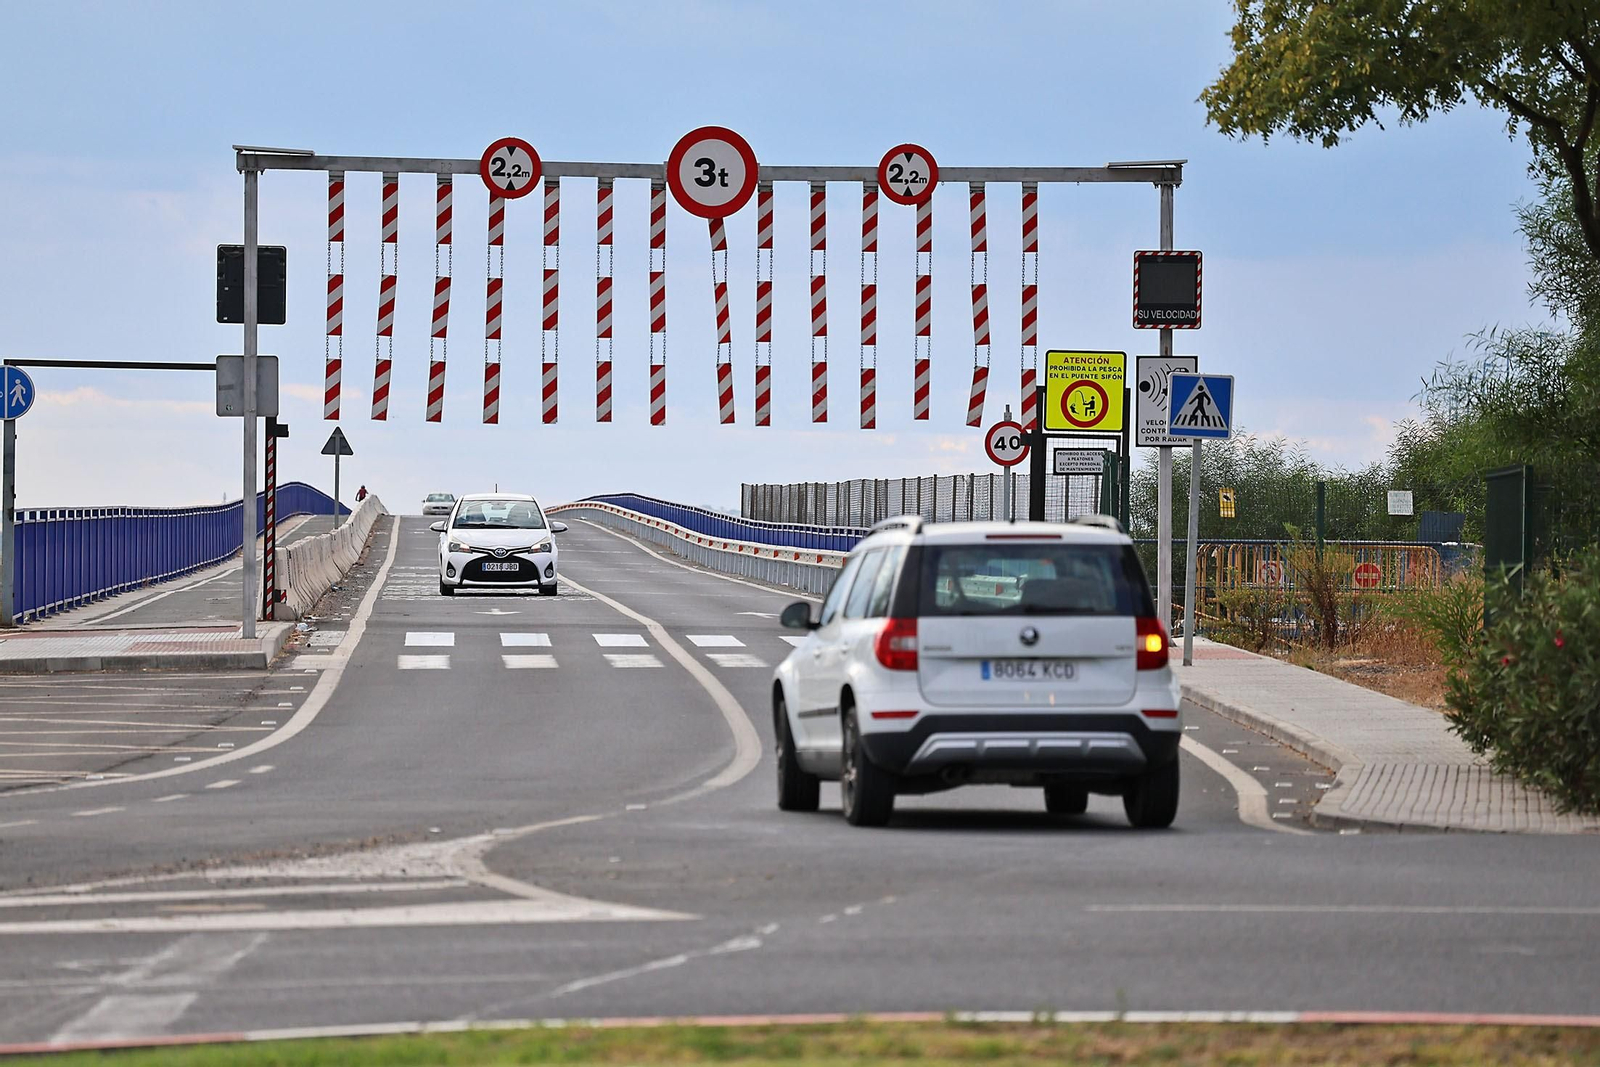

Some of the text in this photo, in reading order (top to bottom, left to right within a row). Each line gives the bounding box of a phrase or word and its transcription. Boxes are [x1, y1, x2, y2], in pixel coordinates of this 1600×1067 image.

[491, 157, 530, 180] 2,2m
[693, 157, 729, 188] 3t
[889, 164, 927, 185] 2,2m
[1138, 310, 1196, 319] SU VELOCIDAD
[1063, 356, 1110, 364] ATENCIÓN
[993, 435, 1021, 451] 40
[1043, 662, 1074, 679] KCD
